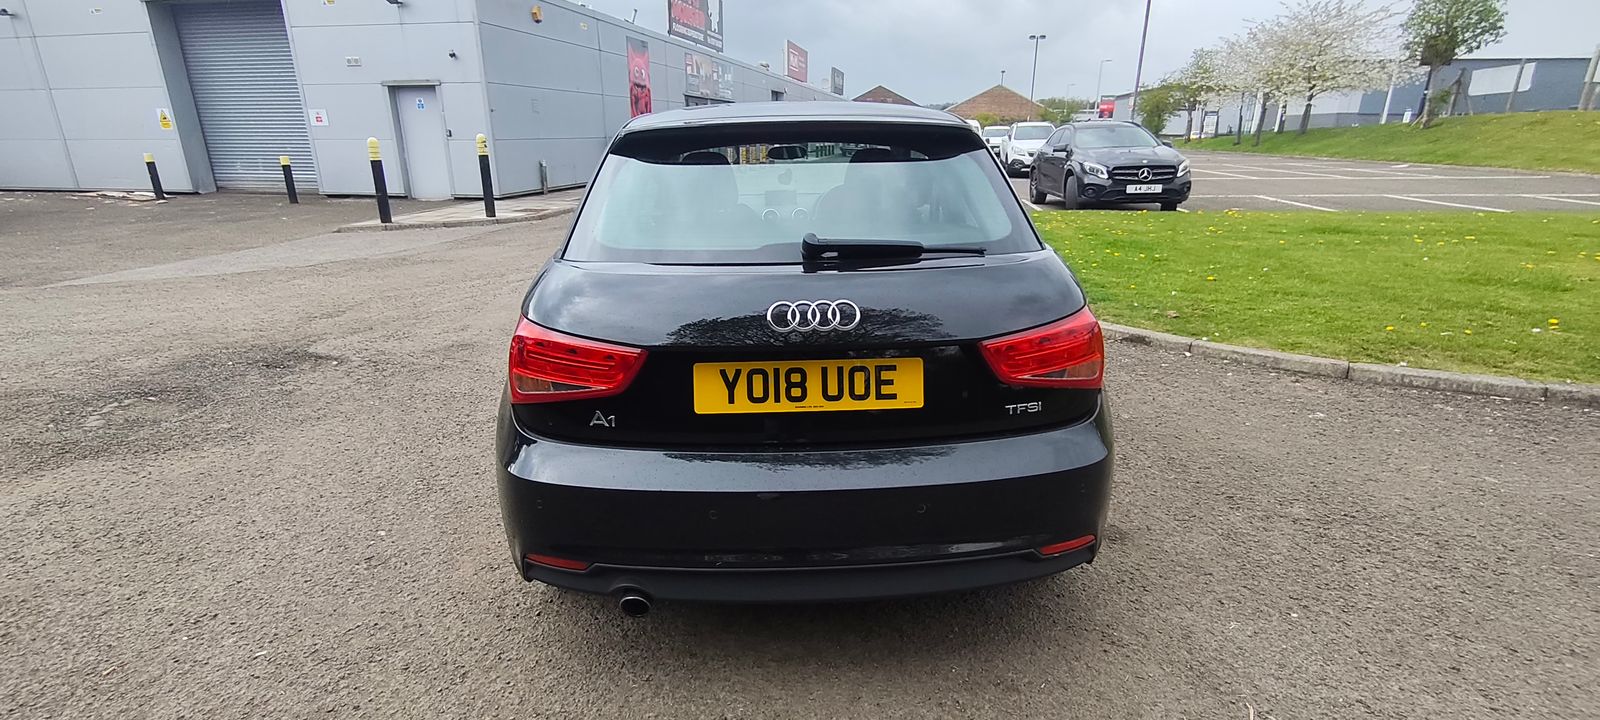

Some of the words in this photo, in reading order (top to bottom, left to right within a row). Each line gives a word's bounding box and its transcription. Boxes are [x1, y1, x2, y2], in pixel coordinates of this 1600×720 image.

[719, 366, 808, 405] YO18
[820, 364, 898, 402] UOE
[1004, 401, 1042, 415] TFSI
[589, 410, 616, 428] A1
